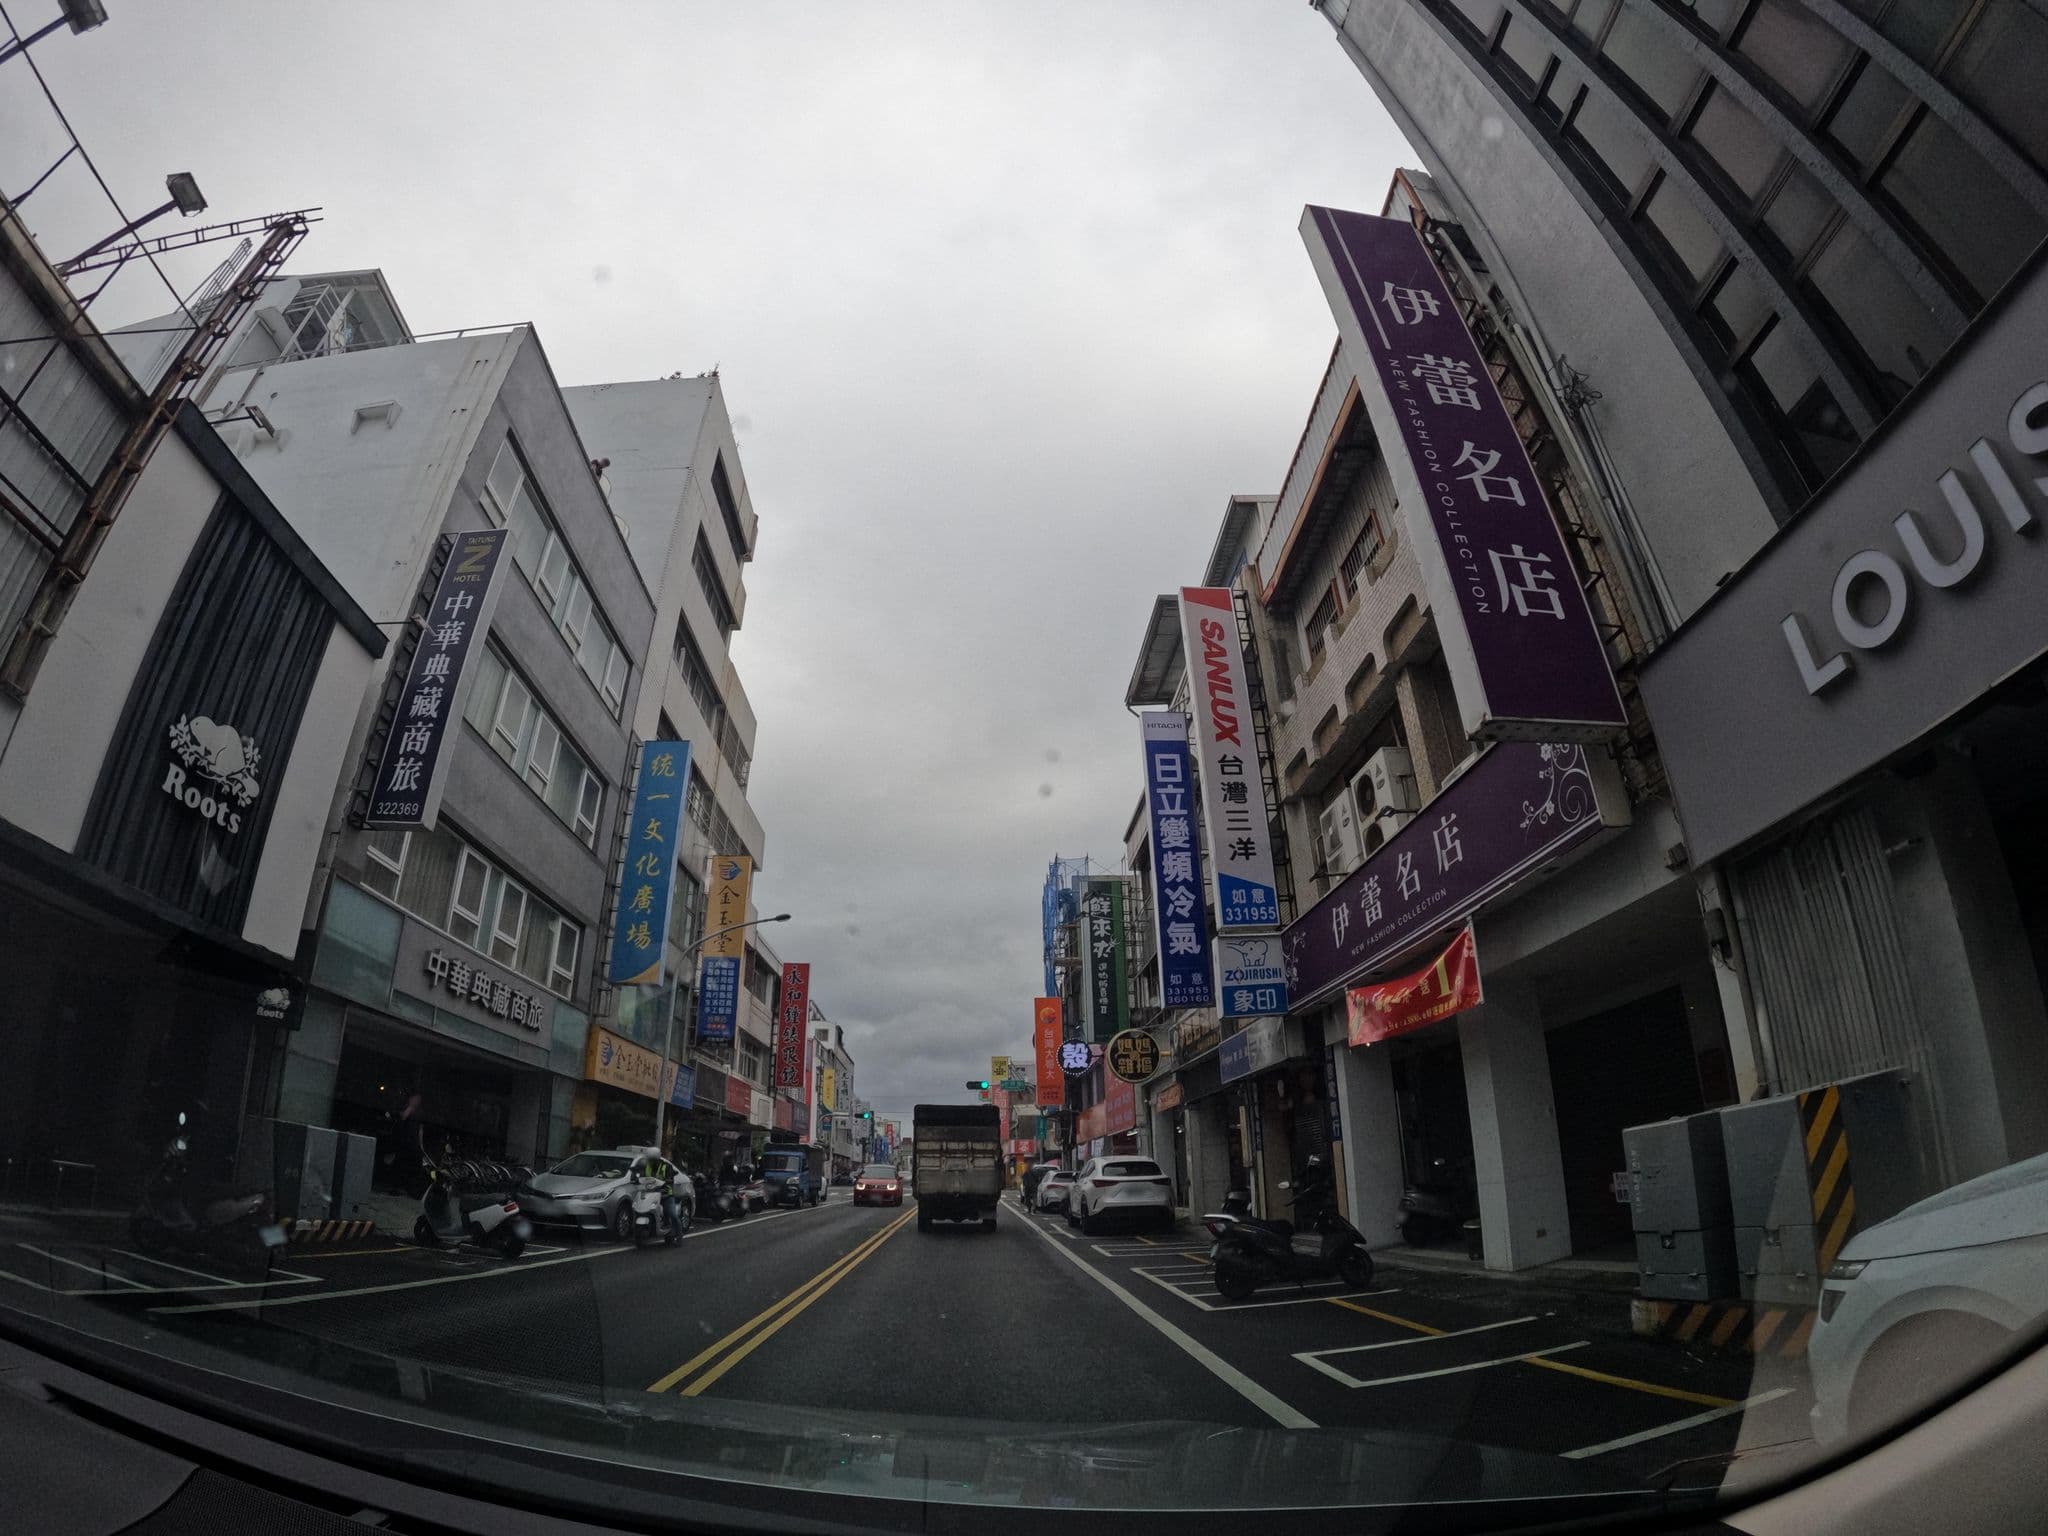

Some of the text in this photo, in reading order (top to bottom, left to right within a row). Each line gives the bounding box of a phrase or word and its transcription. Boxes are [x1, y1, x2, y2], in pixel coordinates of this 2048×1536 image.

[1382, 279, 1566, 621] 伊蕾名店
[1388, 358, 1491, 614] NEW FASHION COLLECTION
[453, 574, 481, 583] HOTEL
[387, 590, 474, 794] 中華典藏商旅
[1200, 617, 1241, 748] SANLUX
[161, 762, 241, 834] Roots
[376, 801, 419, 816] 322369
[1217, 753, 1257, 862] 台灣三洋
[626, 752, 676, 951] 統一文化廣場
[1154, 753, 1202, 956] 日立變頻冷氣
[1331, 812, 1464, 950] 伊蕾名店
[712, 884, 739, 954] 金玉堂
[1225, 906, 1276, 921] 331955
[1232, 888, 1265, 904] 如意
[1351, 887, 1448, 956] NEW FASHION COLLECTION
[426, 950, 545, 1032] 中華典藏商旅
[1167, 986, 1209, 996] 331955
[1225, 967, 1281, 983] ZOJIRUSHI
[1233, 988, 1277, 1012] 象印
[256, 1006, 284, 1020] Roots
[781, 965, 804, 1087] 永和鐘錶眼鏡
